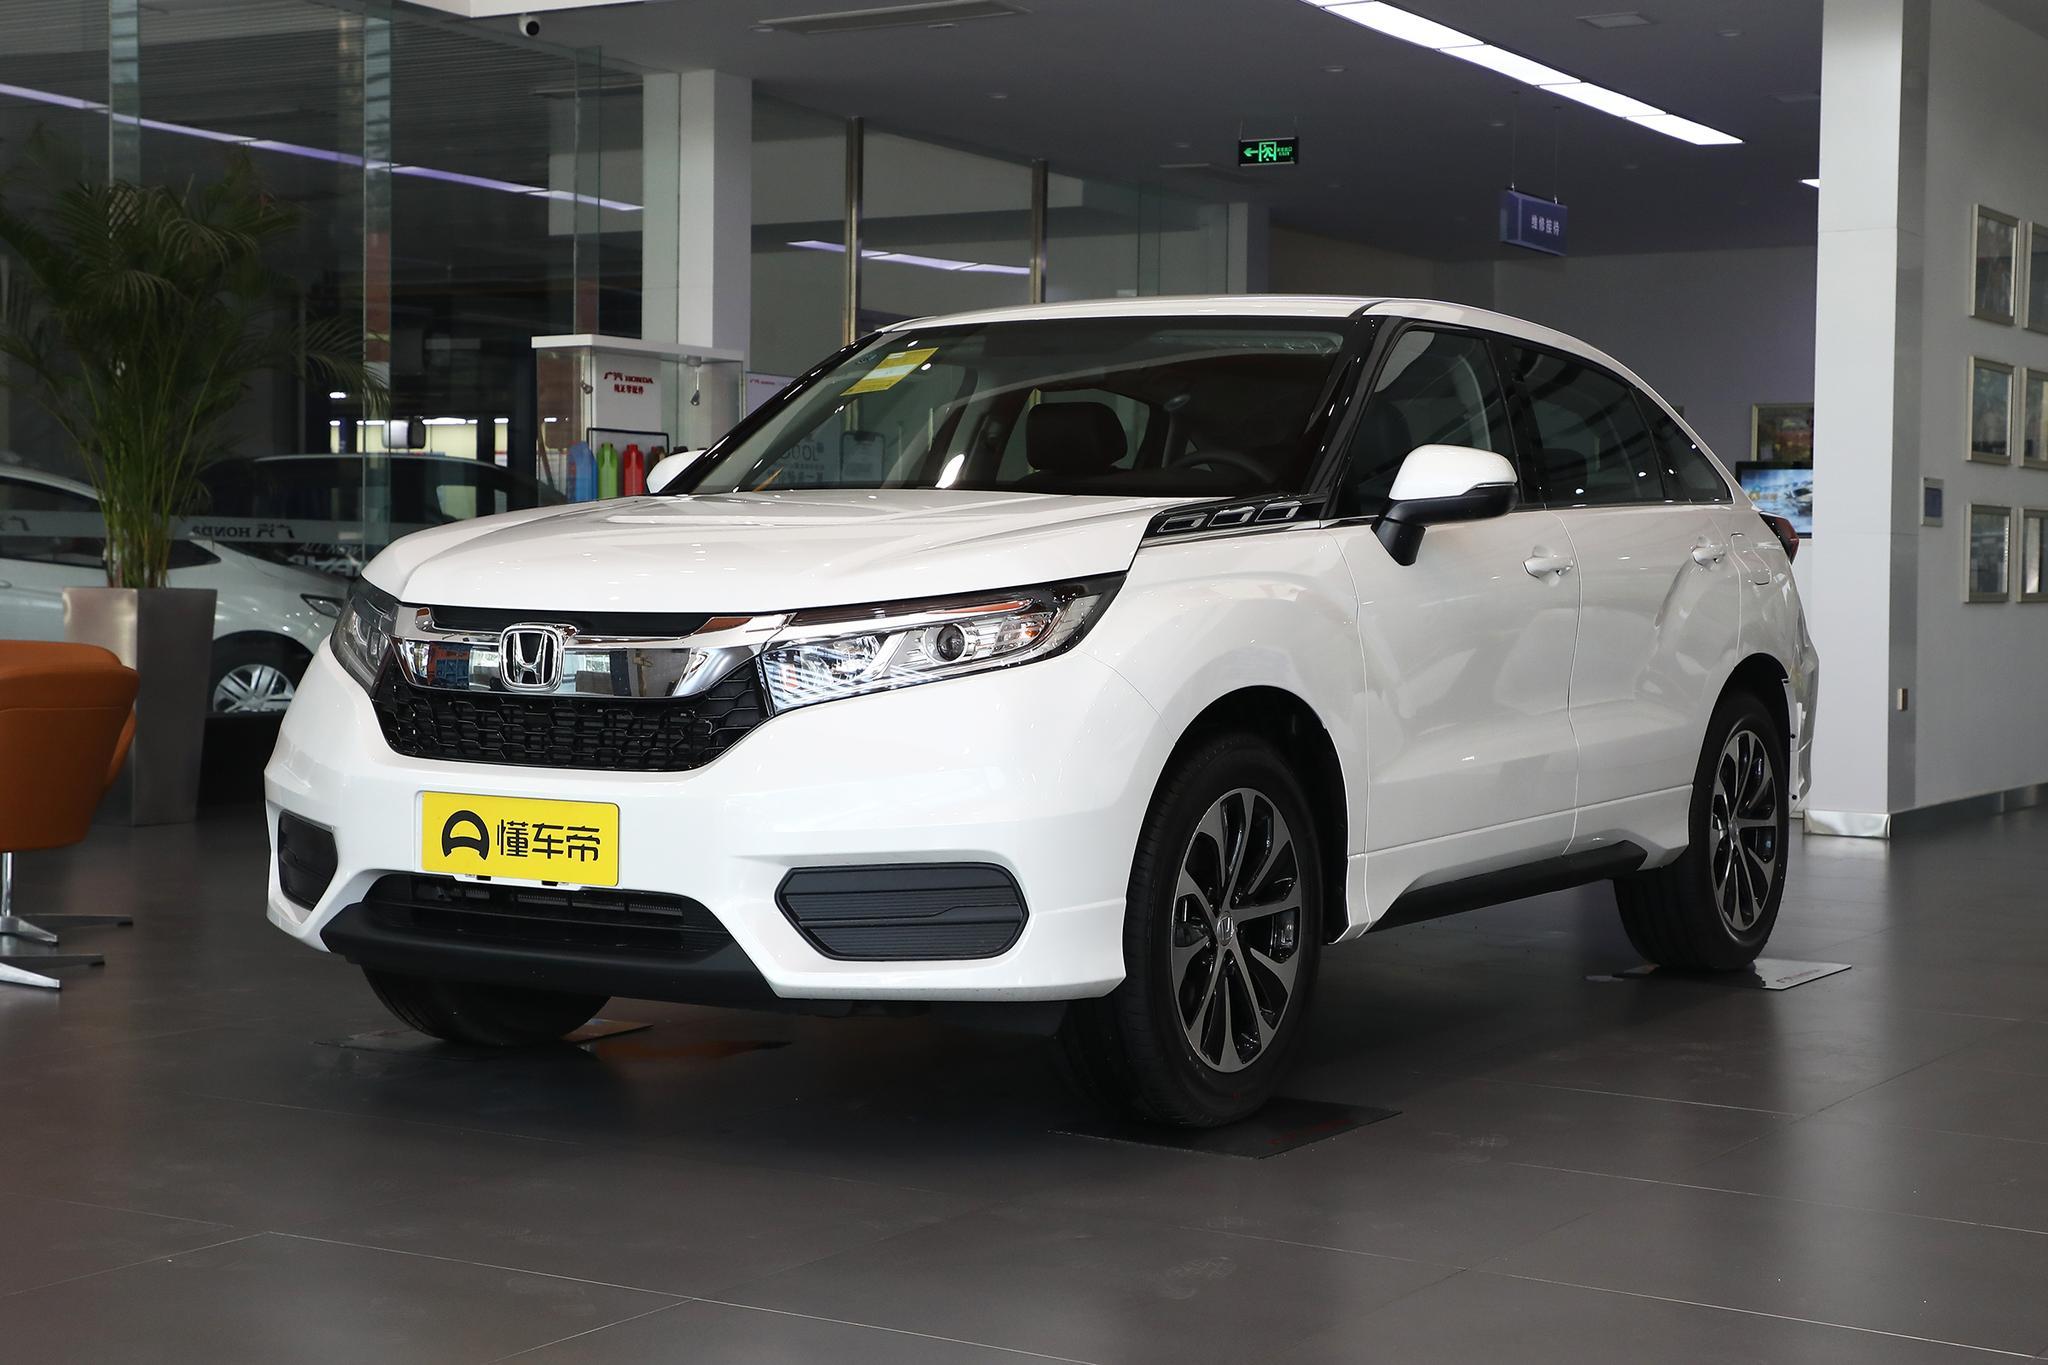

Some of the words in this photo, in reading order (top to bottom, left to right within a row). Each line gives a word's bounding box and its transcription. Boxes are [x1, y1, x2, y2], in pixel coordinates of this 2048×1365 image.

[625, 375, 655, 384] HONDA
[496, 818, 601, 862] 懂车帝
